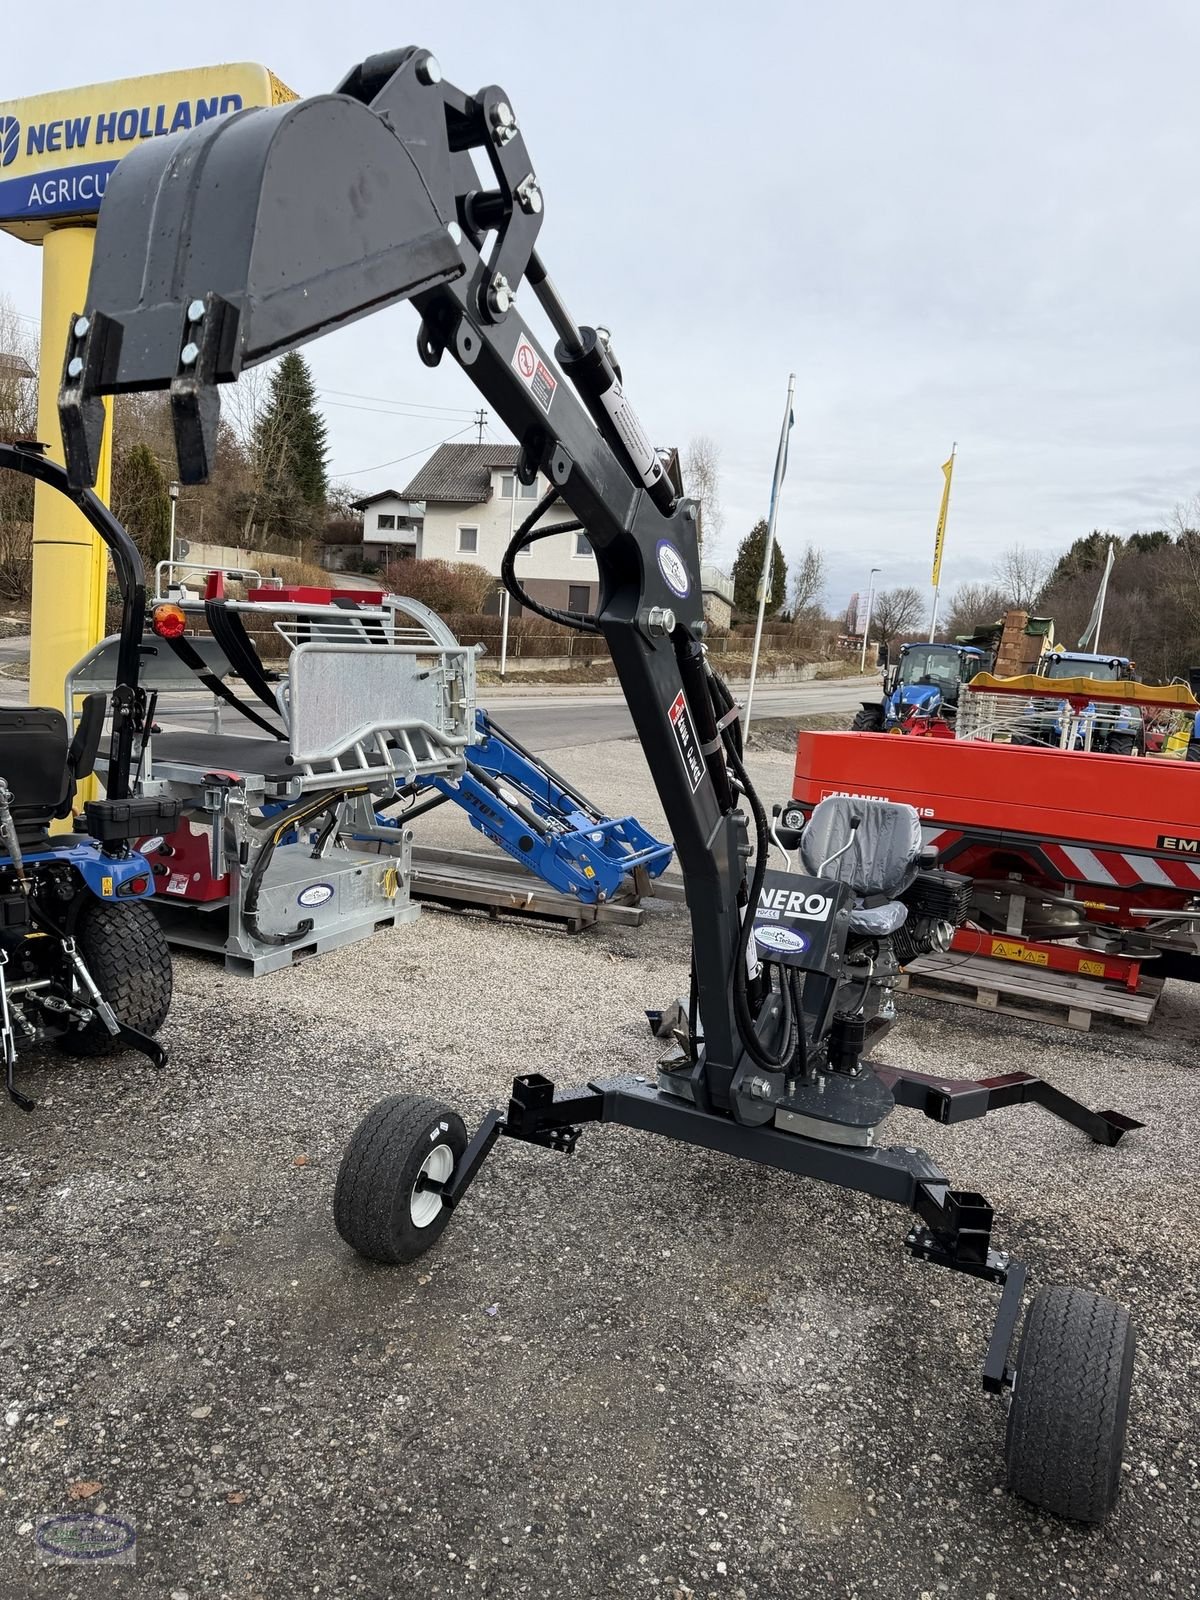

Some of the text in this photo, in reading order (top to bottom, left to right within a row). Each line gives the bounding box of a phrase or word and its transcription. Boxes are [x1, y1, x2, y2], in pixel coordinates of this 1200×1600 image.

[26, 94, 243, 155] NEW HOLLAND
[1163, 837, 1198, 852] EM
[757, 887, 826, 915] NERO
